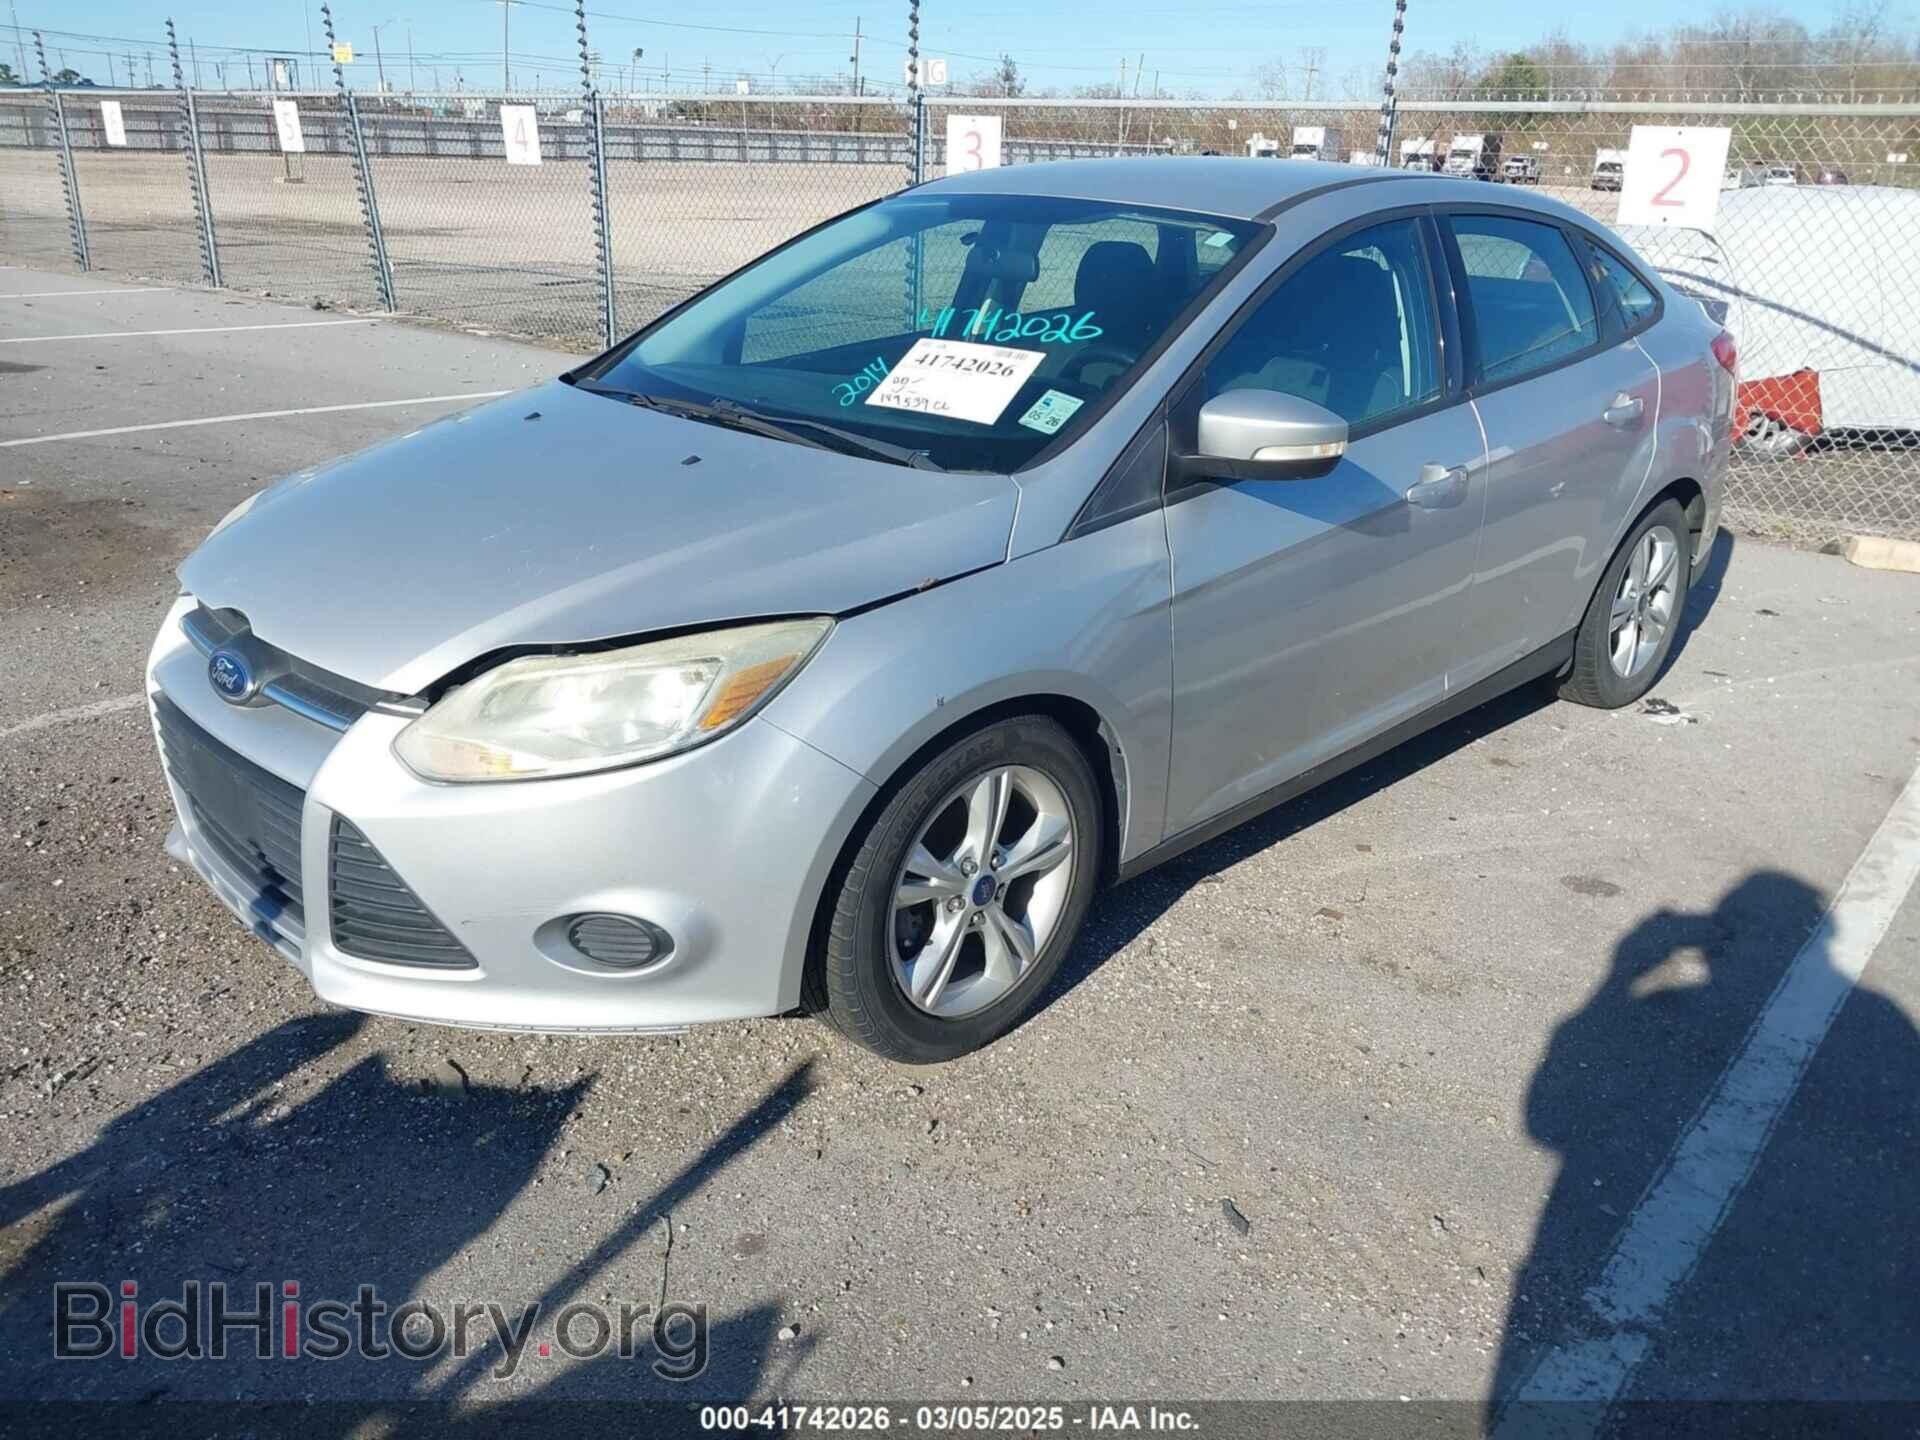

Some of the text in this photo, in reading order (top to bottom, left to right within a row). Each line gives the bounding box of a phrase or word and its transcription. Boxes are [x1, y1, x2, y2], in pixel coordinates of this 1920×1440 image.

[282, 112, 295, 141] 5
[514, 117, 529, 153] 4
[964, 130, 983, 170] 3
[1650, 148, 1691, 206] 2
[919, 306, 1104, 344] 41742026
[831, 355, 889, 407] 2014
[914, 352, 1015, 378] 41742026
[211, 656, 239, 690] Ford
